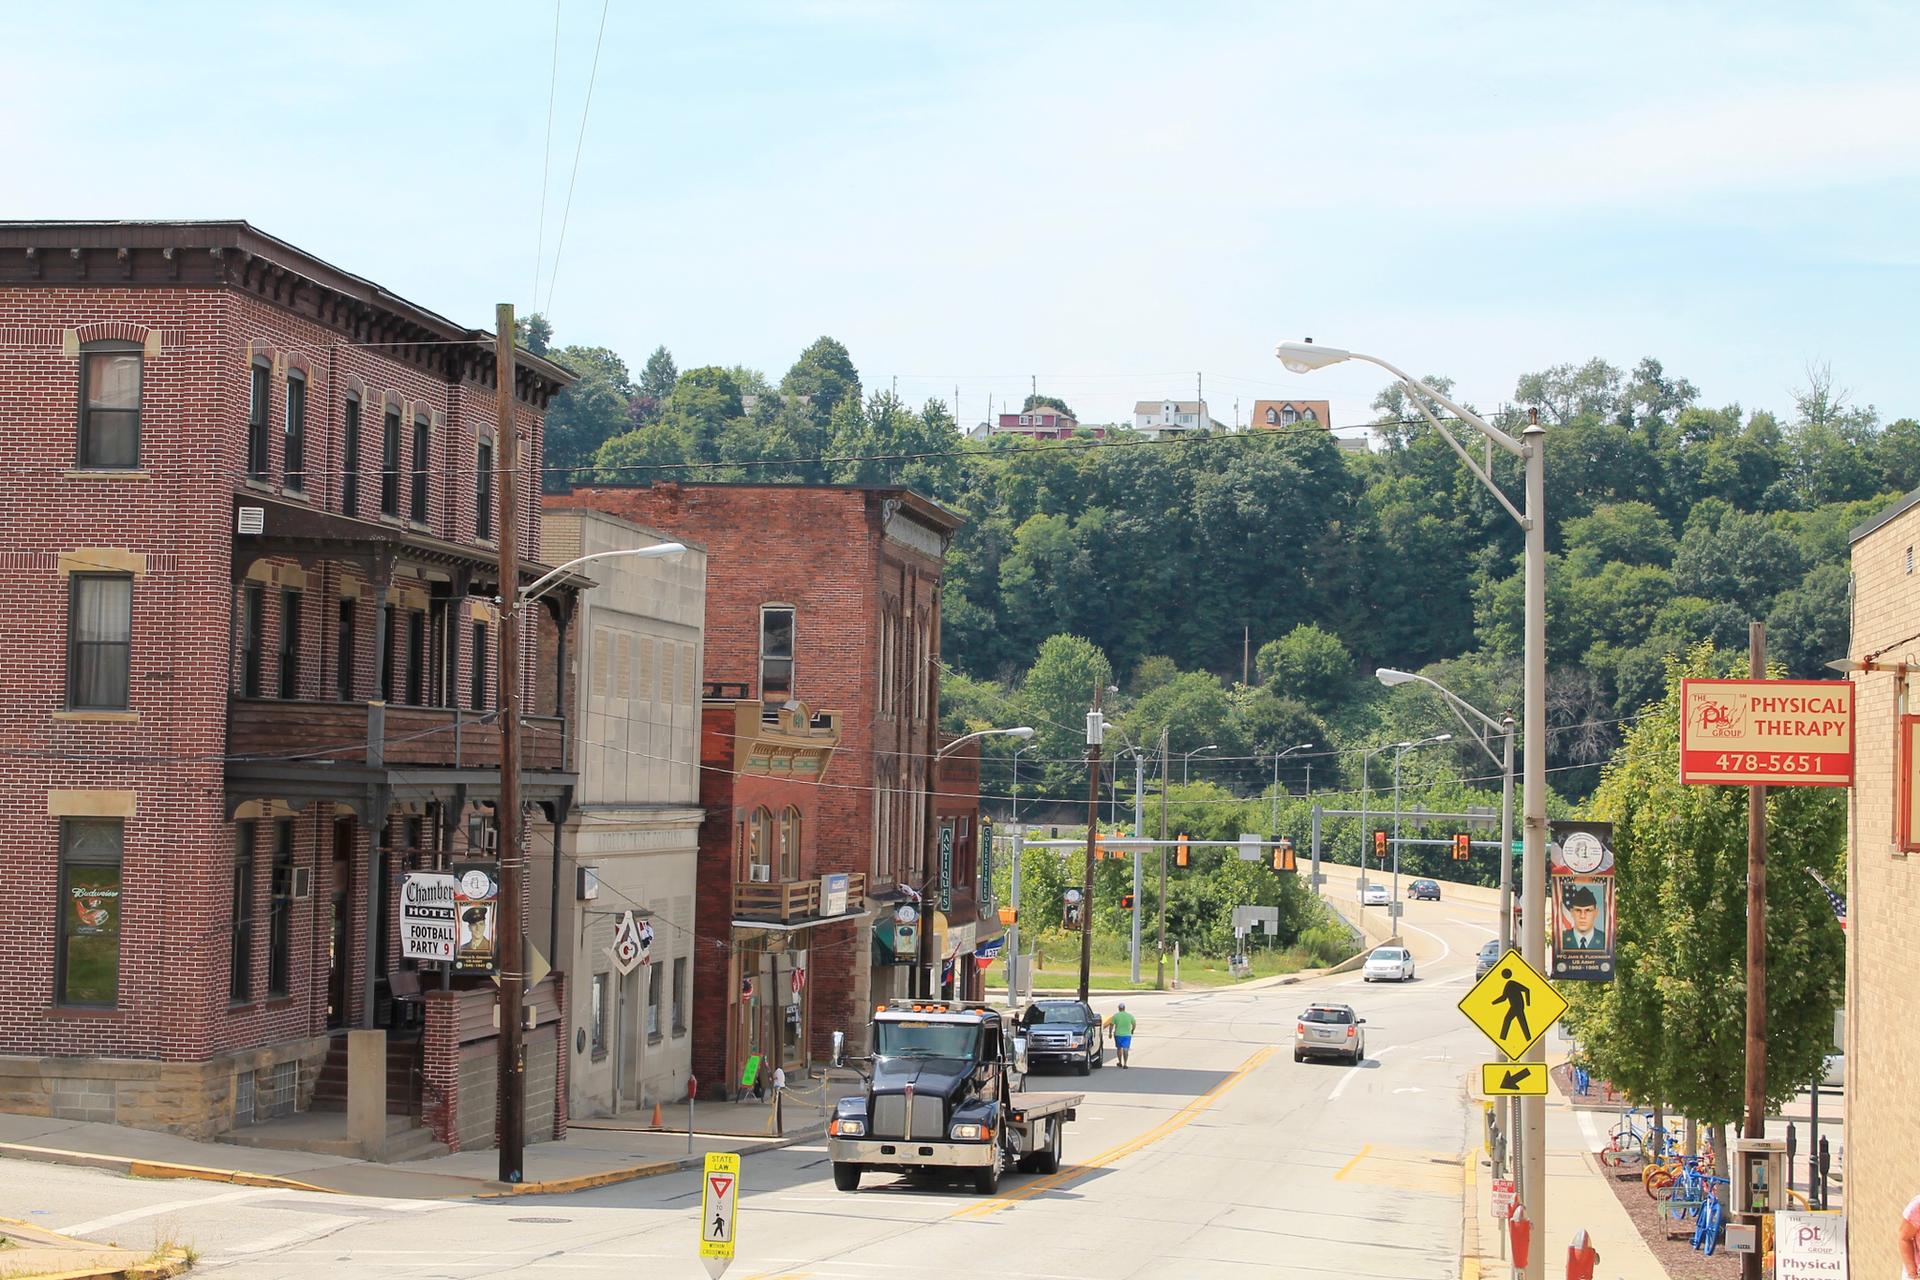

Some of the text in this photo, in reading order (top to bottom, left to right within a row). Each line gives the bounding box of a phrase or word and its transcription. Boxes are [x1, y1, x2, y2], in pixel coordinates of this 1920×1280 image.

[1693, 694, 1707, 702] THE
[1751, 697, 1847, 714] PHYSICAL
[1703, 704, 1729, 730] pt
[1712, 729, 1742, 737] GROUP
[1754, 719, 1846, 737] THERAPY
[1715, 753, 1822, 773] 478-5651
[942, 834, 950, 906] ANTIQUES
[71, 887, 119, 898] Budweiser
[408, 906, 455, 918] HOTEL
[411, 925, 454, 941] FOOTBALL
[410, 940, 450, 955] PARTY 9
[1799, 1226, 1821, 1246] pt
[1782, 1258, 1840, 1272] Physical
